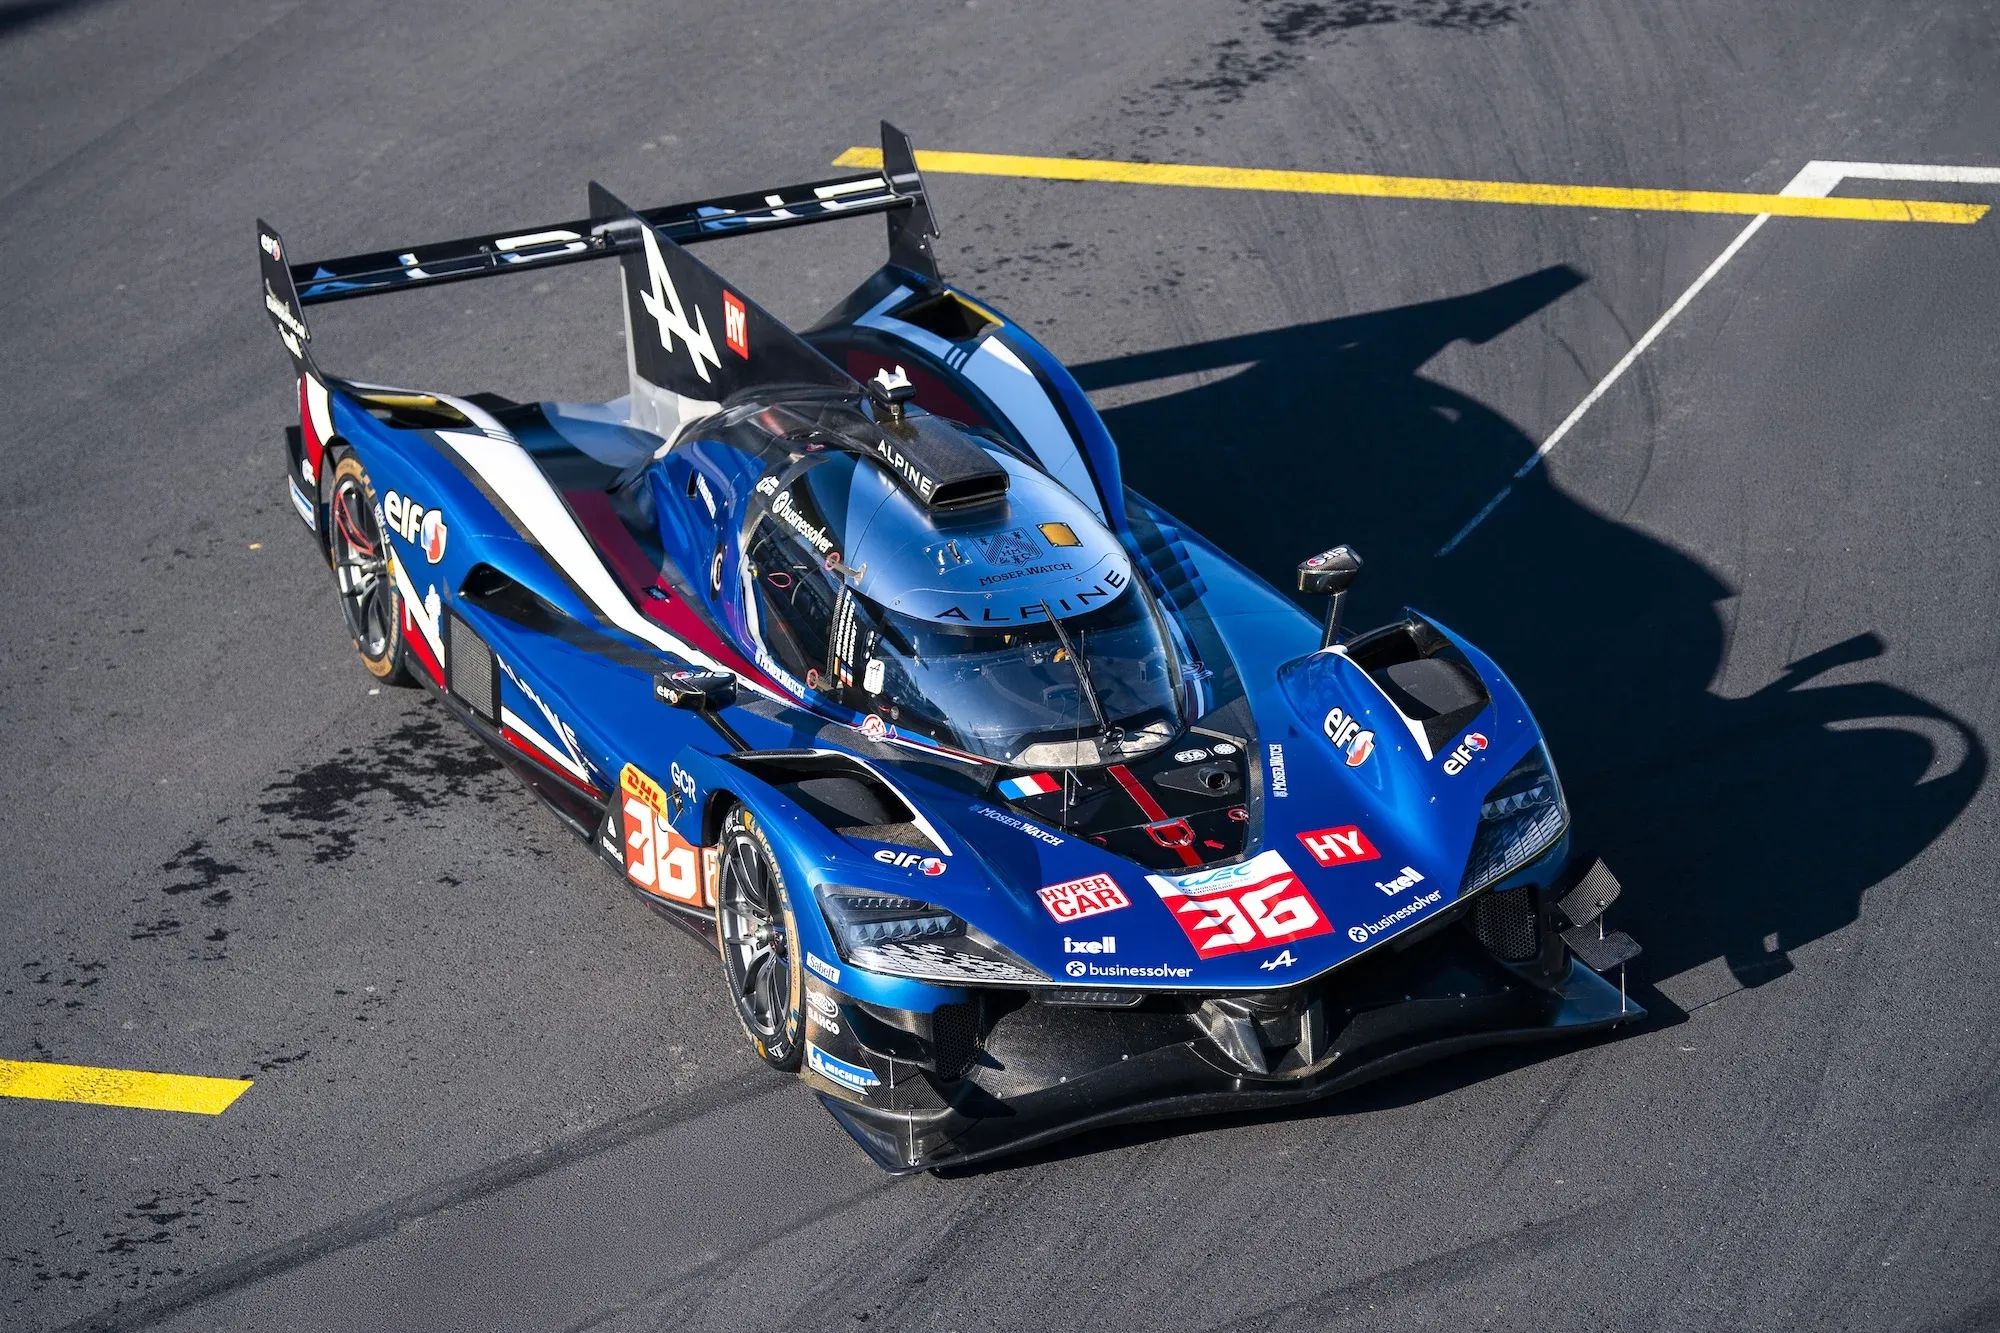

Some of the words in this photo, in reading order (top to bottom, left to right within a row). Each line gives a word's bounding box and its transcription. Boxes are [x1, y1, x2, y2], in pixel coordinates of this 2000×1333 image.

[302, 177, 898, 297] ALPNE
[724, 300, 746, 347] HY
[878, 439, 932, 496] ALPINE
[384, 489, 424, 544] elf
[783, 498, 833, 554] businessolver
[935, 569, 1126, 622] ALPINE
[1323, 707, 1359, 749] elf
[1443, 746, 1473, 777] elf
[627, 766, 661, 813] DHL
[624, 798, 697, 900] 36
[873, 849, 921, 869] elf
[1304, 830, 1365, 861] HY
[1041, 877, 1111, 902] HYPER
[1375, 866, 1425, 897] ixell
[1051, 888, 1122, 918] CAR
[1177, 878, 1320, 951] 36
[1363, 889, 1442, 935] businessolver
[1064, 936, 1116, 954] ixell
[808, 955, 836, 982] Sabelt
[1089, 963, 1193, 978] businessolver
[807, 1007, 840, 1036] BAHCO
